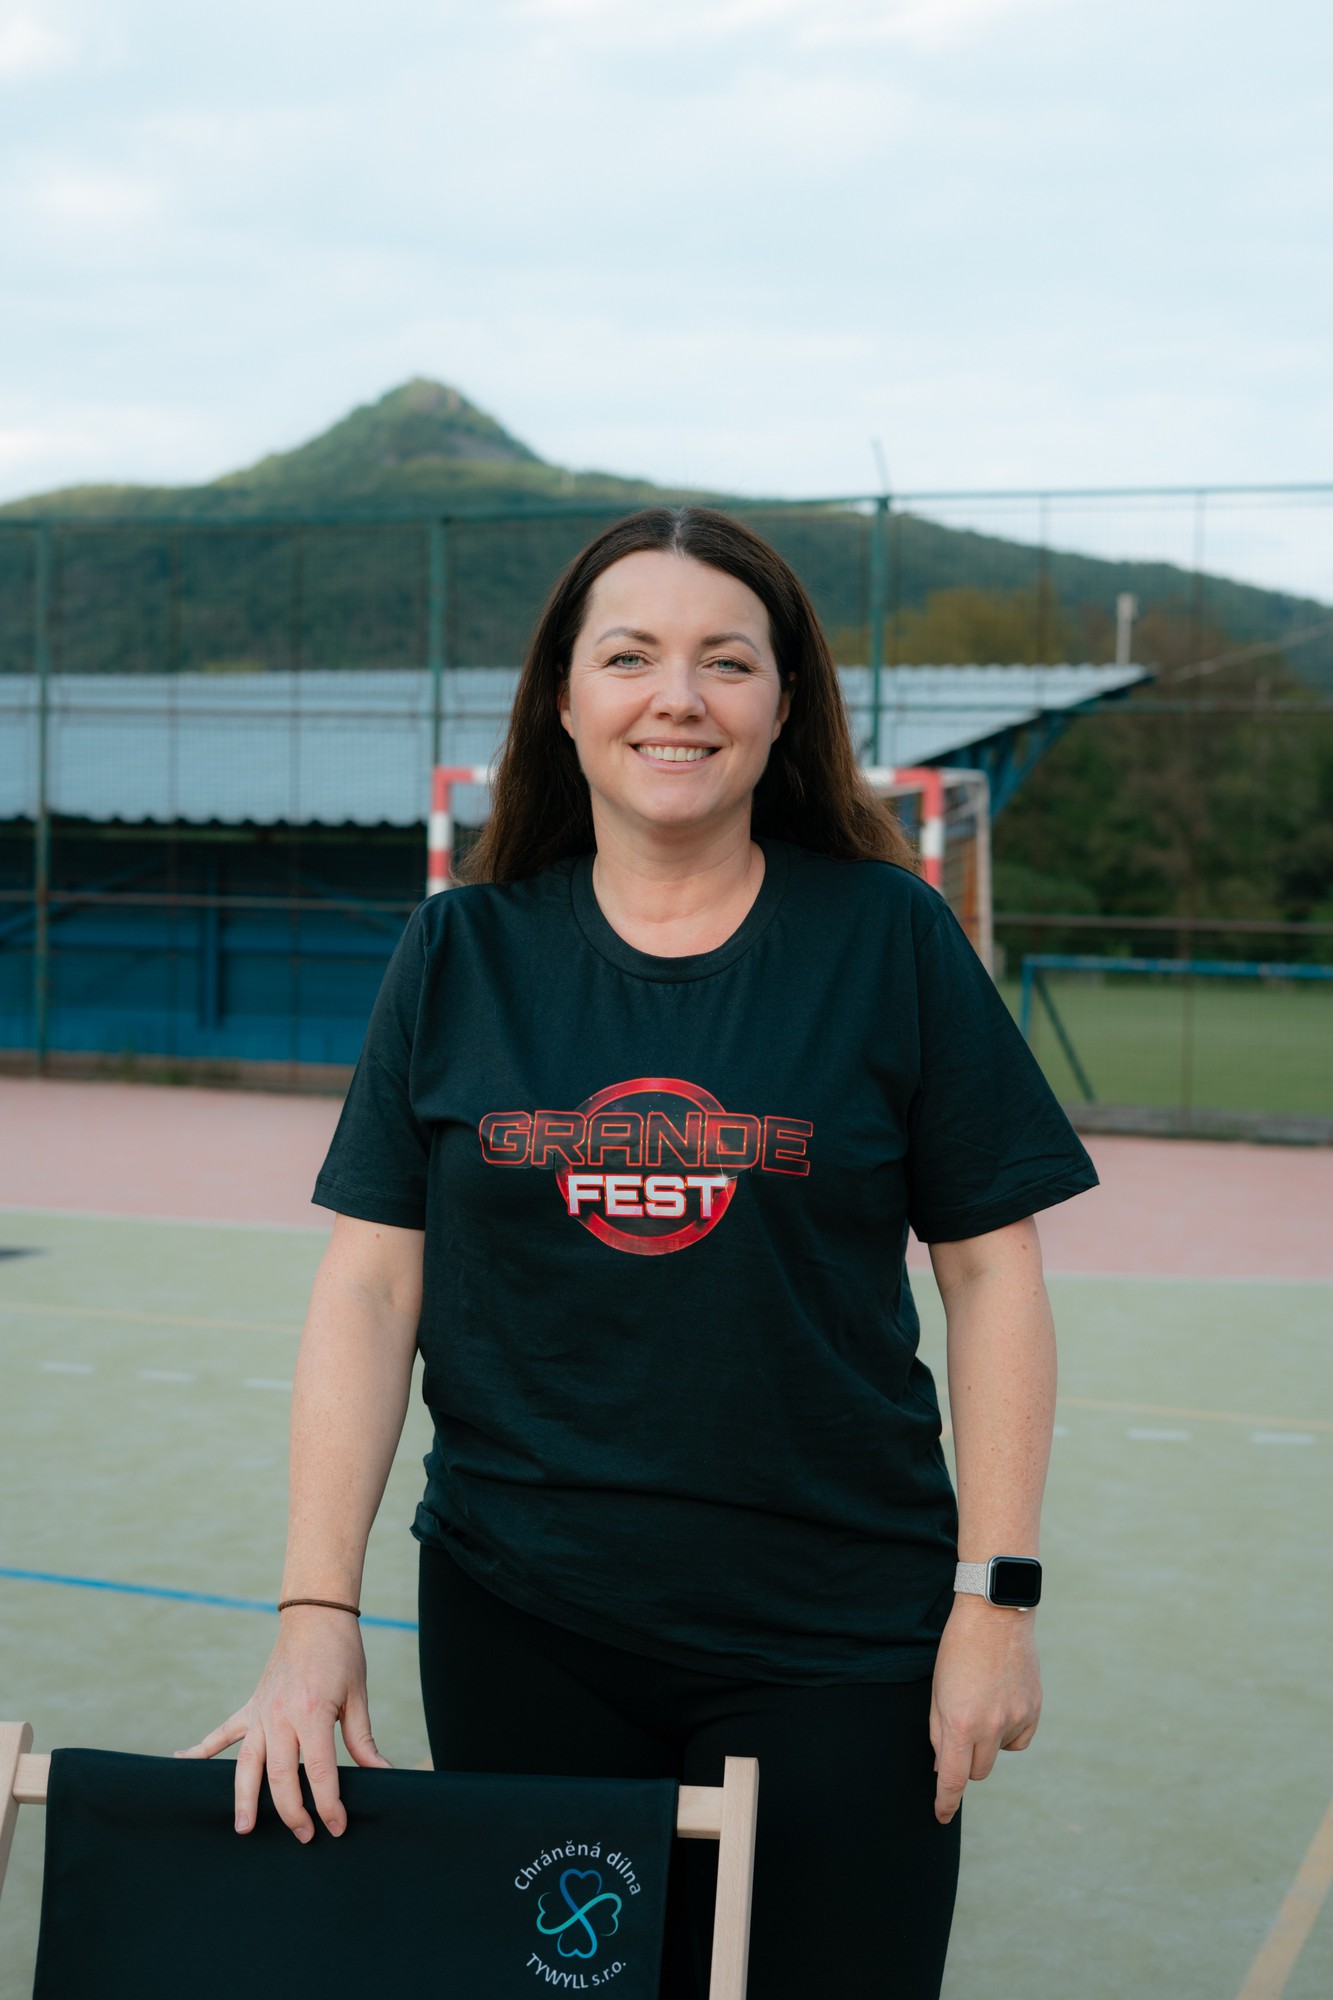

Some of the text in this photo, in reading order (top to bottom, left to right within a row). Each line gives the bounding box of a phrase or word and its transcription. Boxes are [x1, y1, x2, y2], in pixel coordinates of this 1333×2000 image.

[479, 1110, 813, 1176] GRANDE
[566, 1173, 728, 1218] FEST
[514, 1840, 641, 1895] Chráněná dílna
[526, 1952, 627, 1989] TYWYLL s.r.o.
